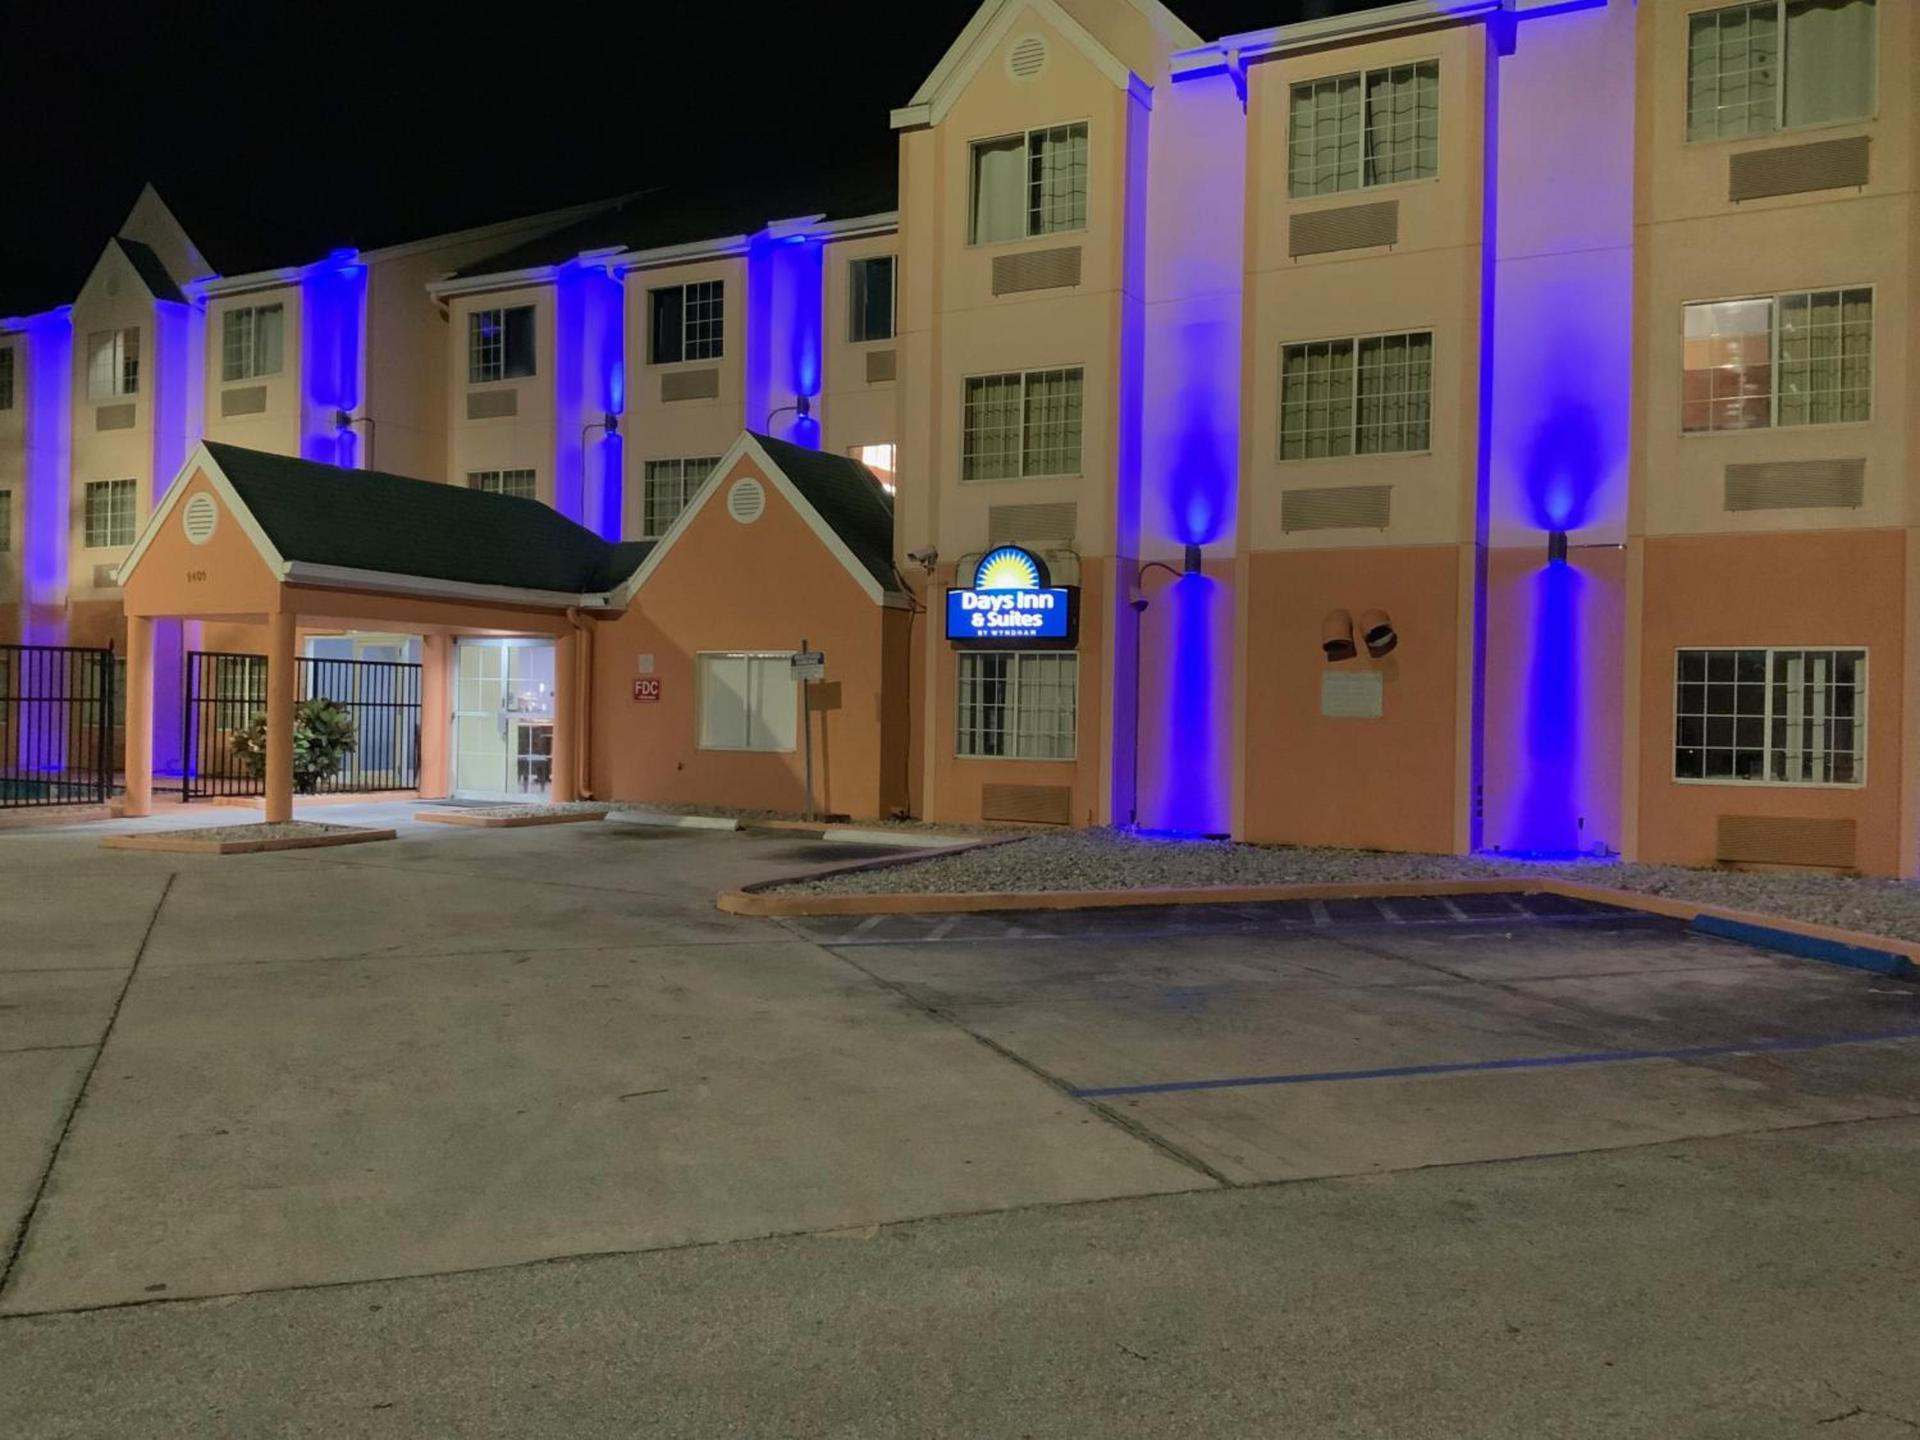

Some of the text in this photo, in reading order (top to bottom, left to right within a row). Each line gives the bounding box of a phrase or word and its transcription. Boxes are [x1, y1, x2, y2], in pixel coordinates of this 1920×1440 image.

[962, 591, 1054, 611] Days Inn
[971, 611, 1043, 627] & Suites
[635, 681, 658, 695] FDC
